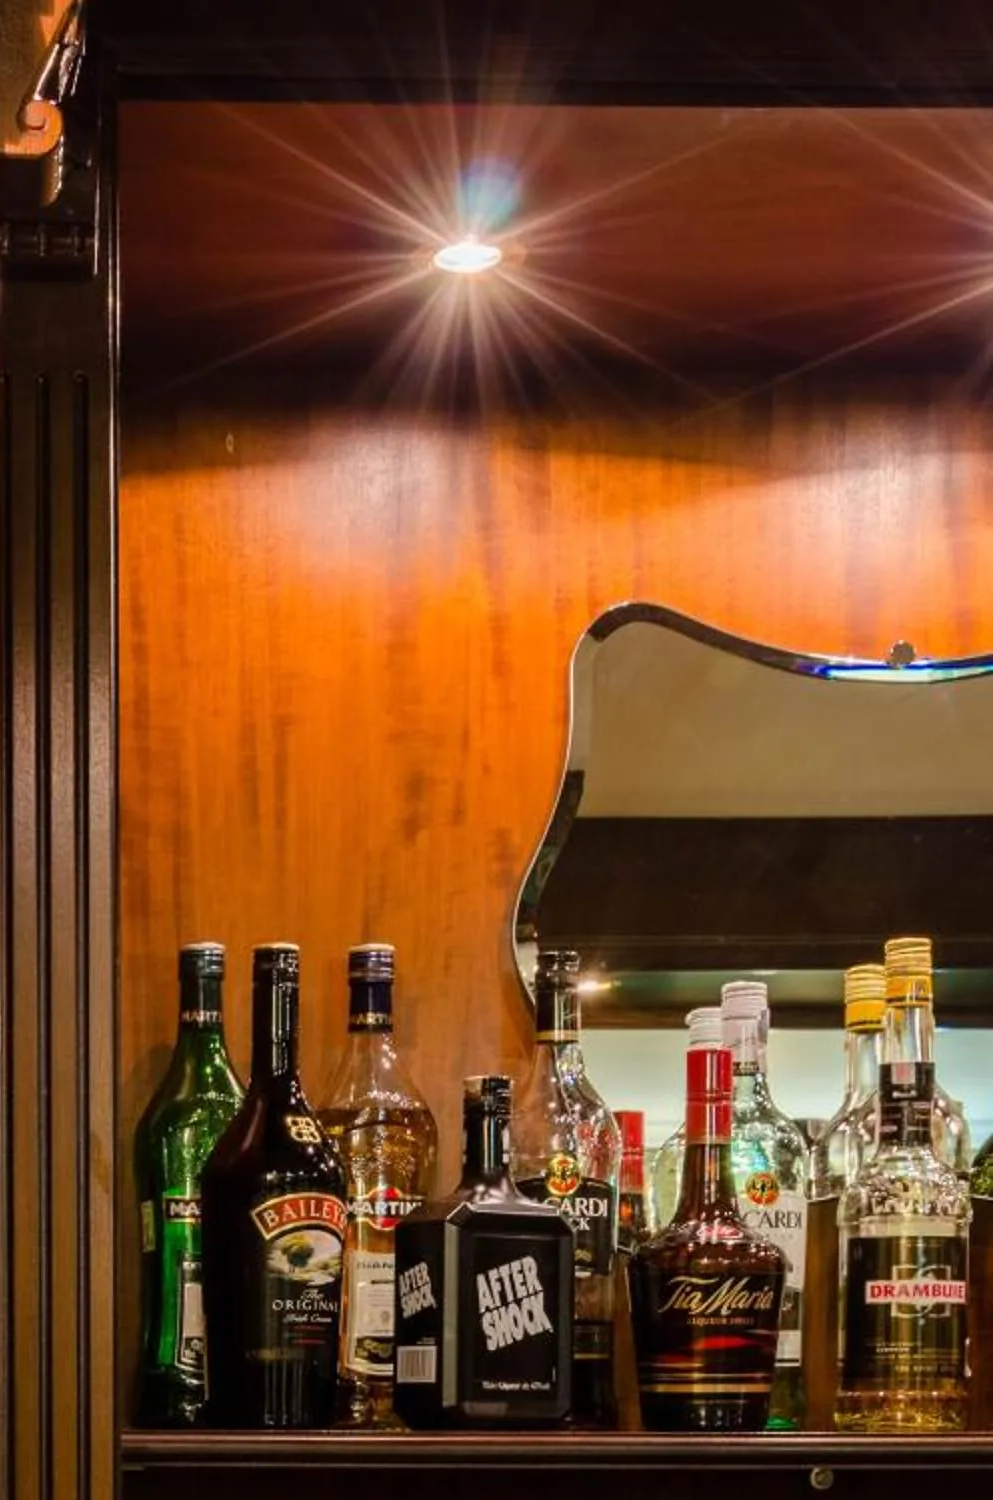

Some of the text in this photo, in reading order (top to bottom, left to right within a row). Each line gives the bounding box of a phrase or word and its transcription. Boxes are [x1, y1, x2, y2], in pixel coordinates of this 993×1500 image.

[476, 1255, 544, 1314] AFTER
[870, 1284, 964, 1299] DRAMBUIE
[481, 1291, 554, 1351] SHOCK
